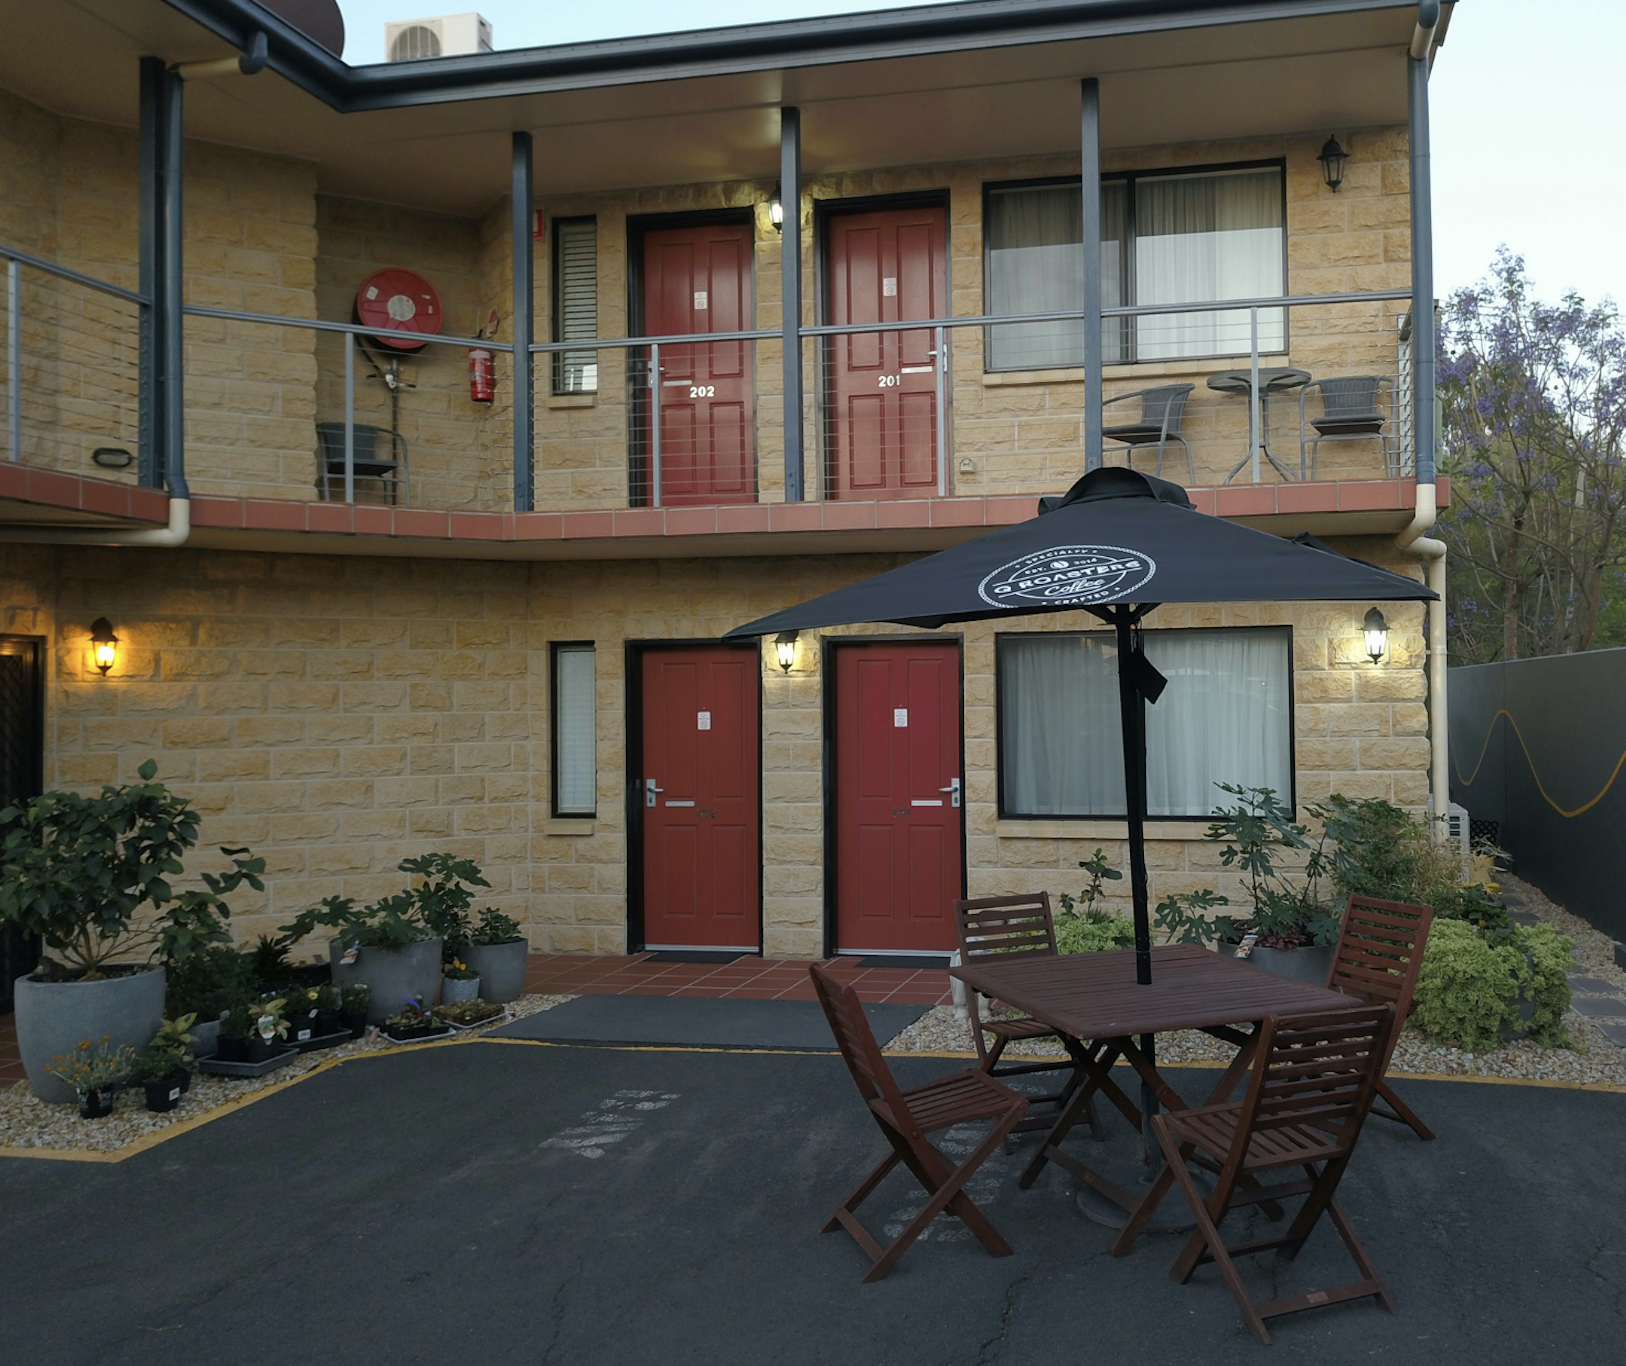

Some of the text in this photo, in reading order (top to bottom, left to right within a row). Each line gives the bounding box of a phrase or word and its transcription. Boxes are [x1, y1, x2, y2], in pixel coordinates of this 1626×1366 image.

[878, 374, 901, 388] 201
[689, 385, 715, 398] 202
[1018, 560, 1141, 590] ROASTERS
[1044, 578, 1106, 597] Coffee
[1054, 590, 1110, 606] CRAFTED
